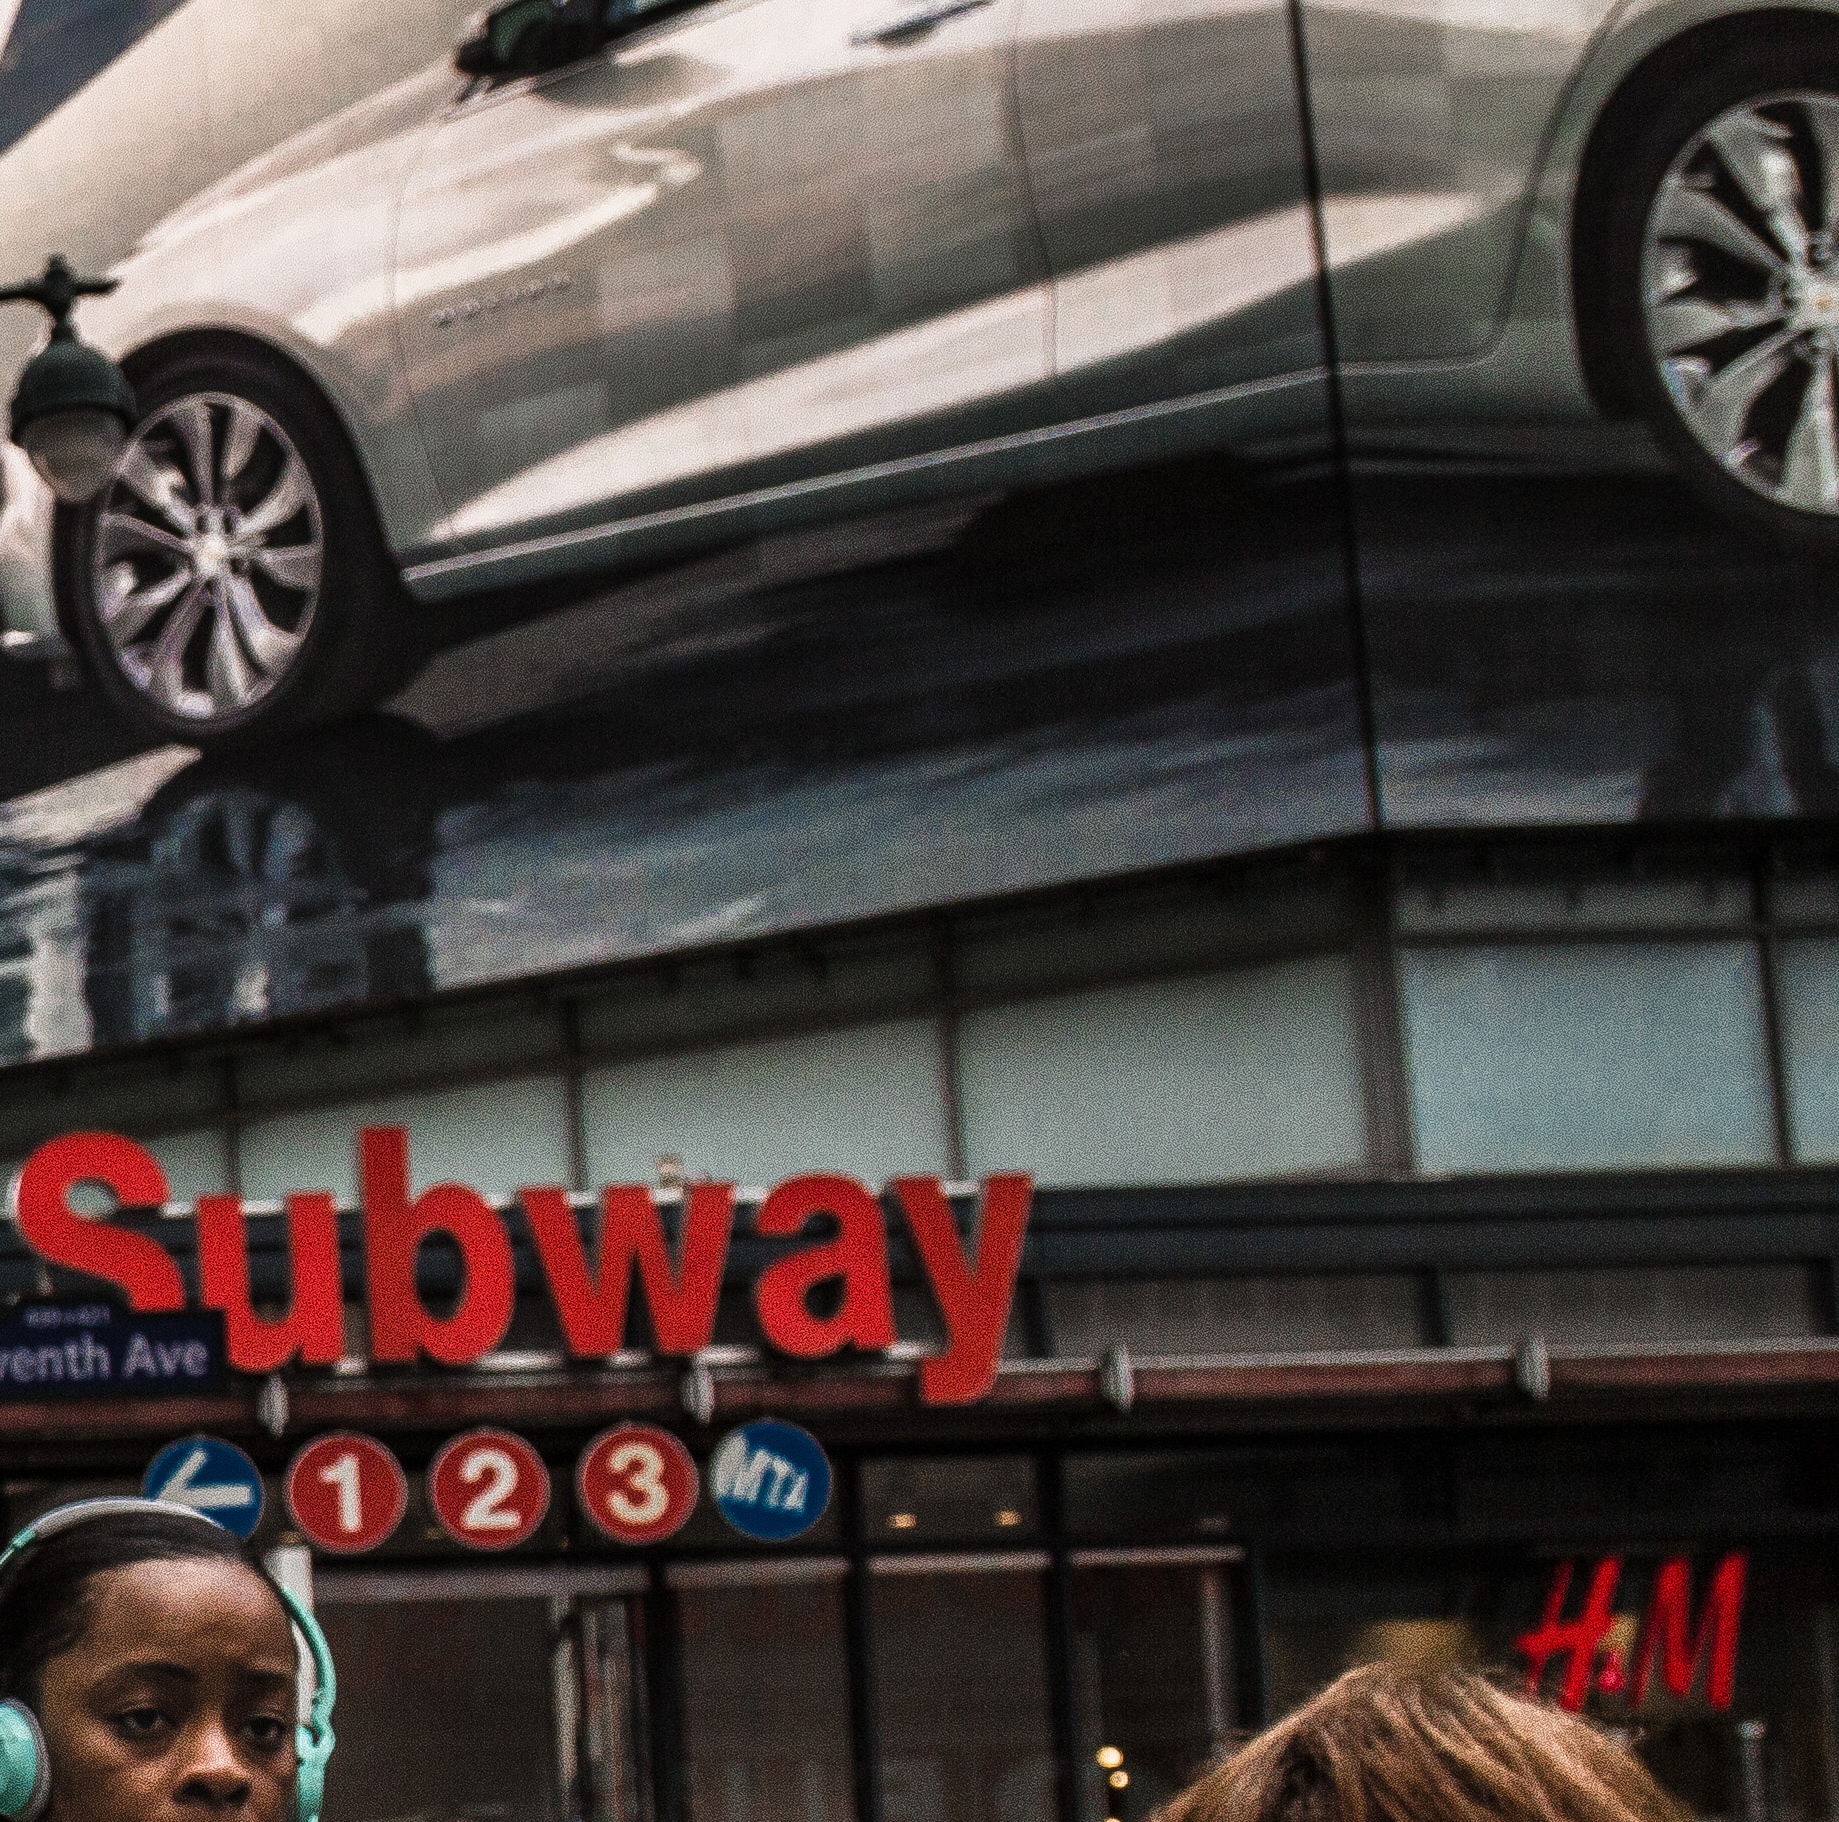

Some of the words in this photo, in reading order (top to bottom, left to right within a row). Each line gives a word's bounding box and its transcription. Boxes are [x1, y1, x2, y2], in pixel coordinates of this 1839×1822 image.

[11, 1126, 1033, 1404] Subway
[123, 1333, 209, 1381] Ave
[320, 1452, 362, 1534] 1
[463, 1450, 521, 1531] 2
[609, 1443, 669, 1524] 3
[711, 1432, 810, 1514] MTA
[1515, 1551, 1748, 1713] H&M
